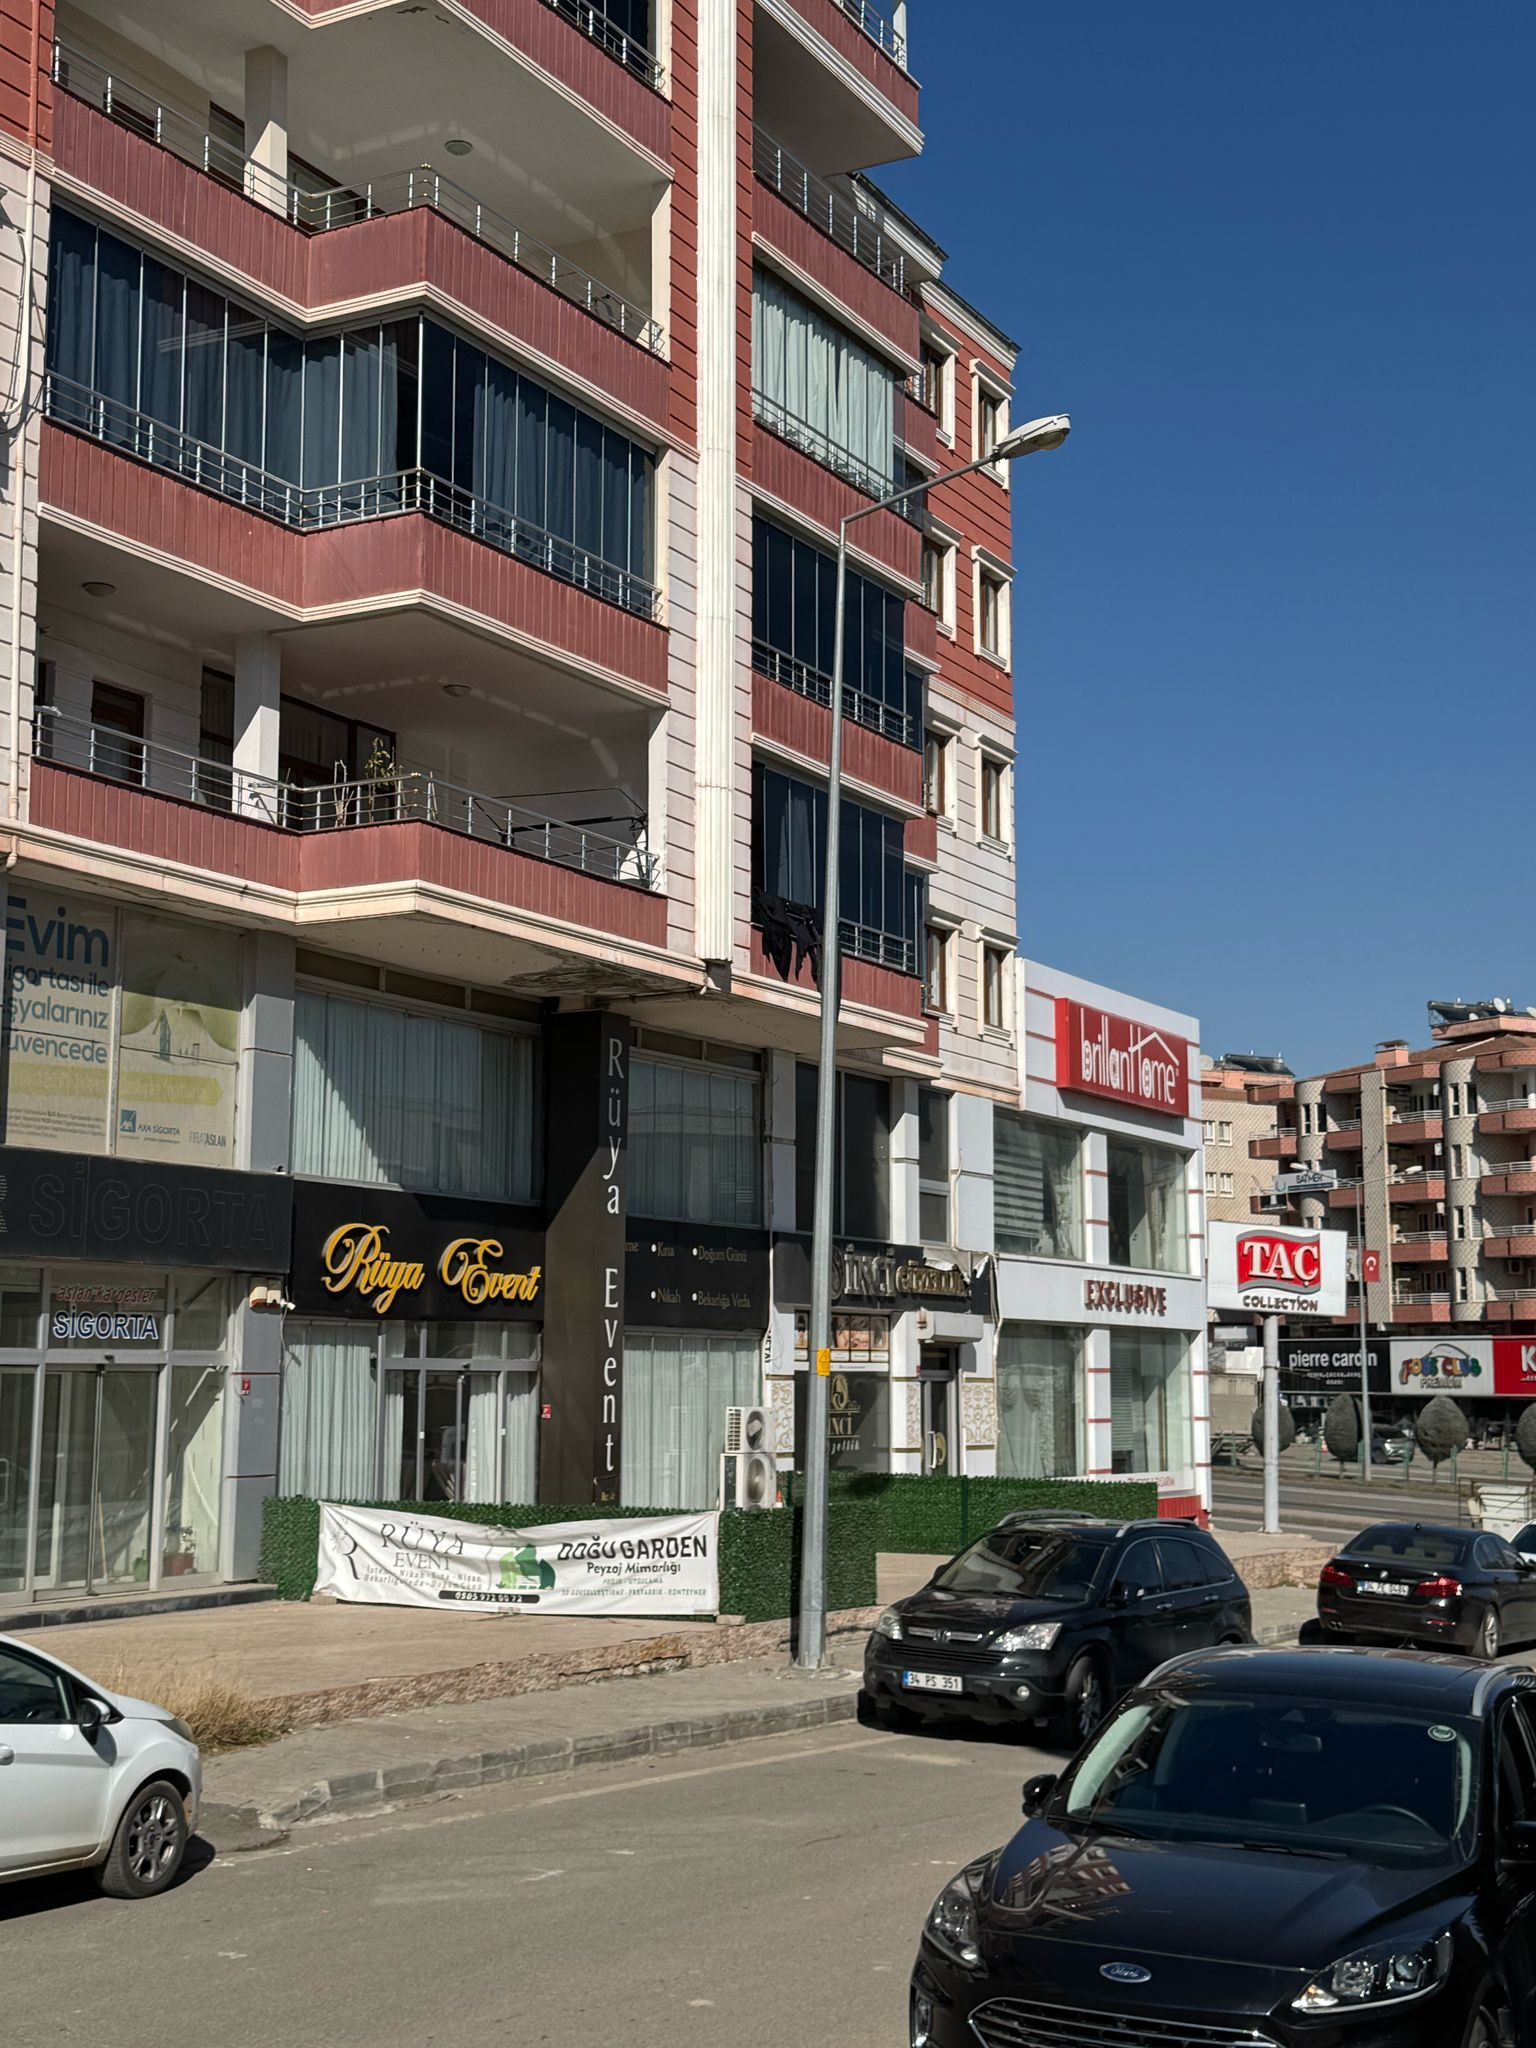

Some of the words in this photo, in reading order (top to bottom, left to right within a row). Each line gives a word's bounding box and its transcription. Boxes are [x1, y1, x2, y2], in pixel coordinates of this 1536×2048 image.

[6, 896, 109, 967] Evim
[89, 972, 109, 997] ile
[28, 1162, 274, 1250] SİGORTA
[321, 1222, 426, 1314] Rüya
[437, 1237, 542, 1305] Event
[1242, 1240, 1319, 1287] TAÇ
[1084, 1279, 1167, 1315] EXCLUSIVE
[53, 1304, 159, 1340] SİGORTA
[602, 1267, 619, 1472] Event
[1288, 1349, 1329, 1371] pierre
[380, 1520, 464, 1555] RÜYA
[557, 1535, 615, 1561] DOĞU
[619, 1535, 707, 1560] GARDEN
[393, 1552, 451, 1571] EVENT
[587, 1562, 622, 1576] Peyzaj
[624, 1561, 681, 1575] Mimarlığı
[908, 1673, 920, 1685] 34
[942, 1677, 959, 1689] 351
